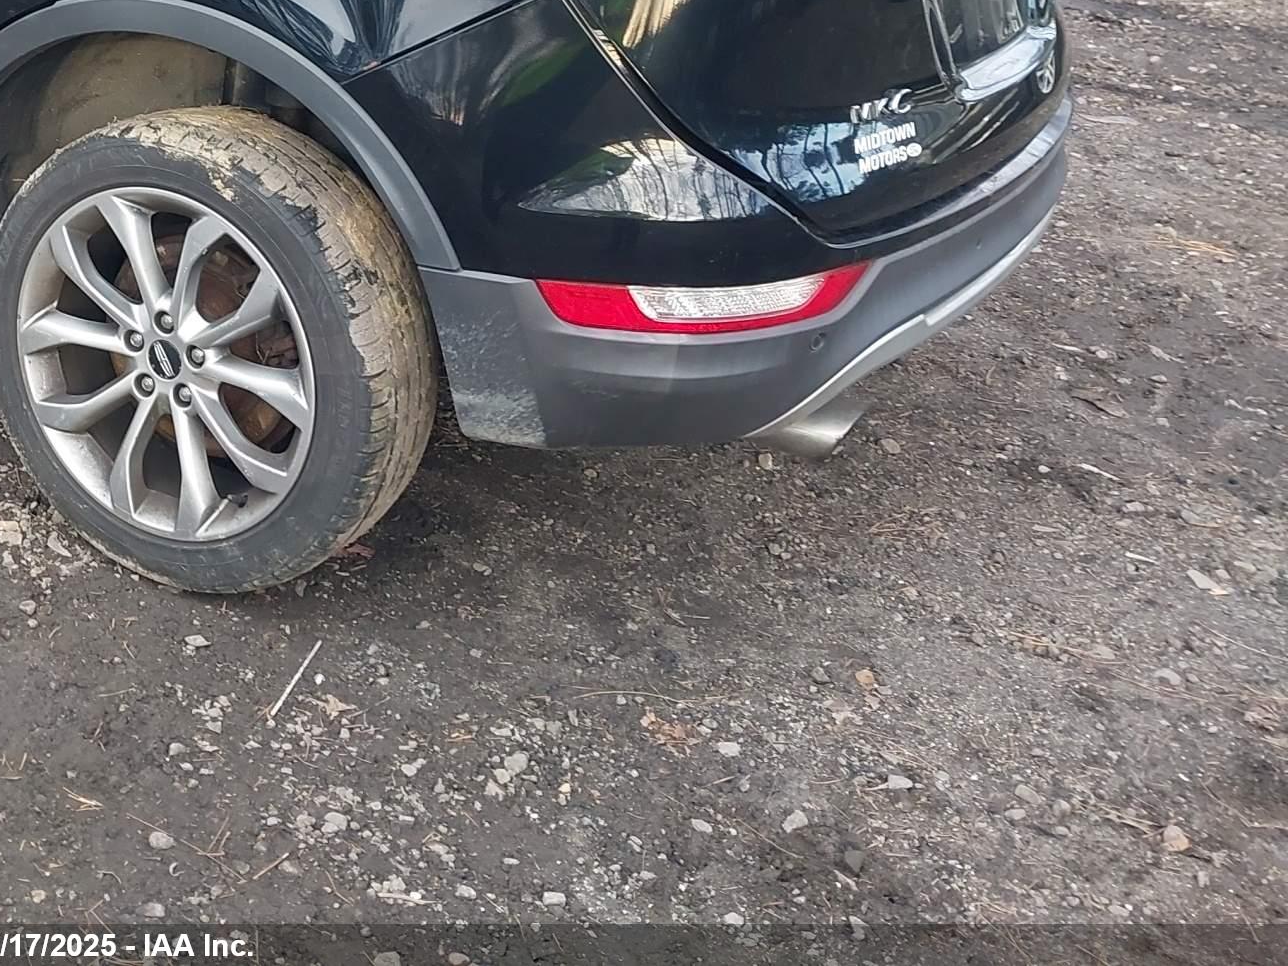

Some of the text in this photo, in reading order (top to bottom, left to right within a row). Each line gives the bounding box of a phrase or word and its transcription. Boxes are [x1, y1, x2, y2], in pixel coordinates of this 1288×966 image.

[850, 88, 912, 124] MKC
[854, 121, 916, 154] MIDTOWN
[858, 145, 908, 174] MOTORS
